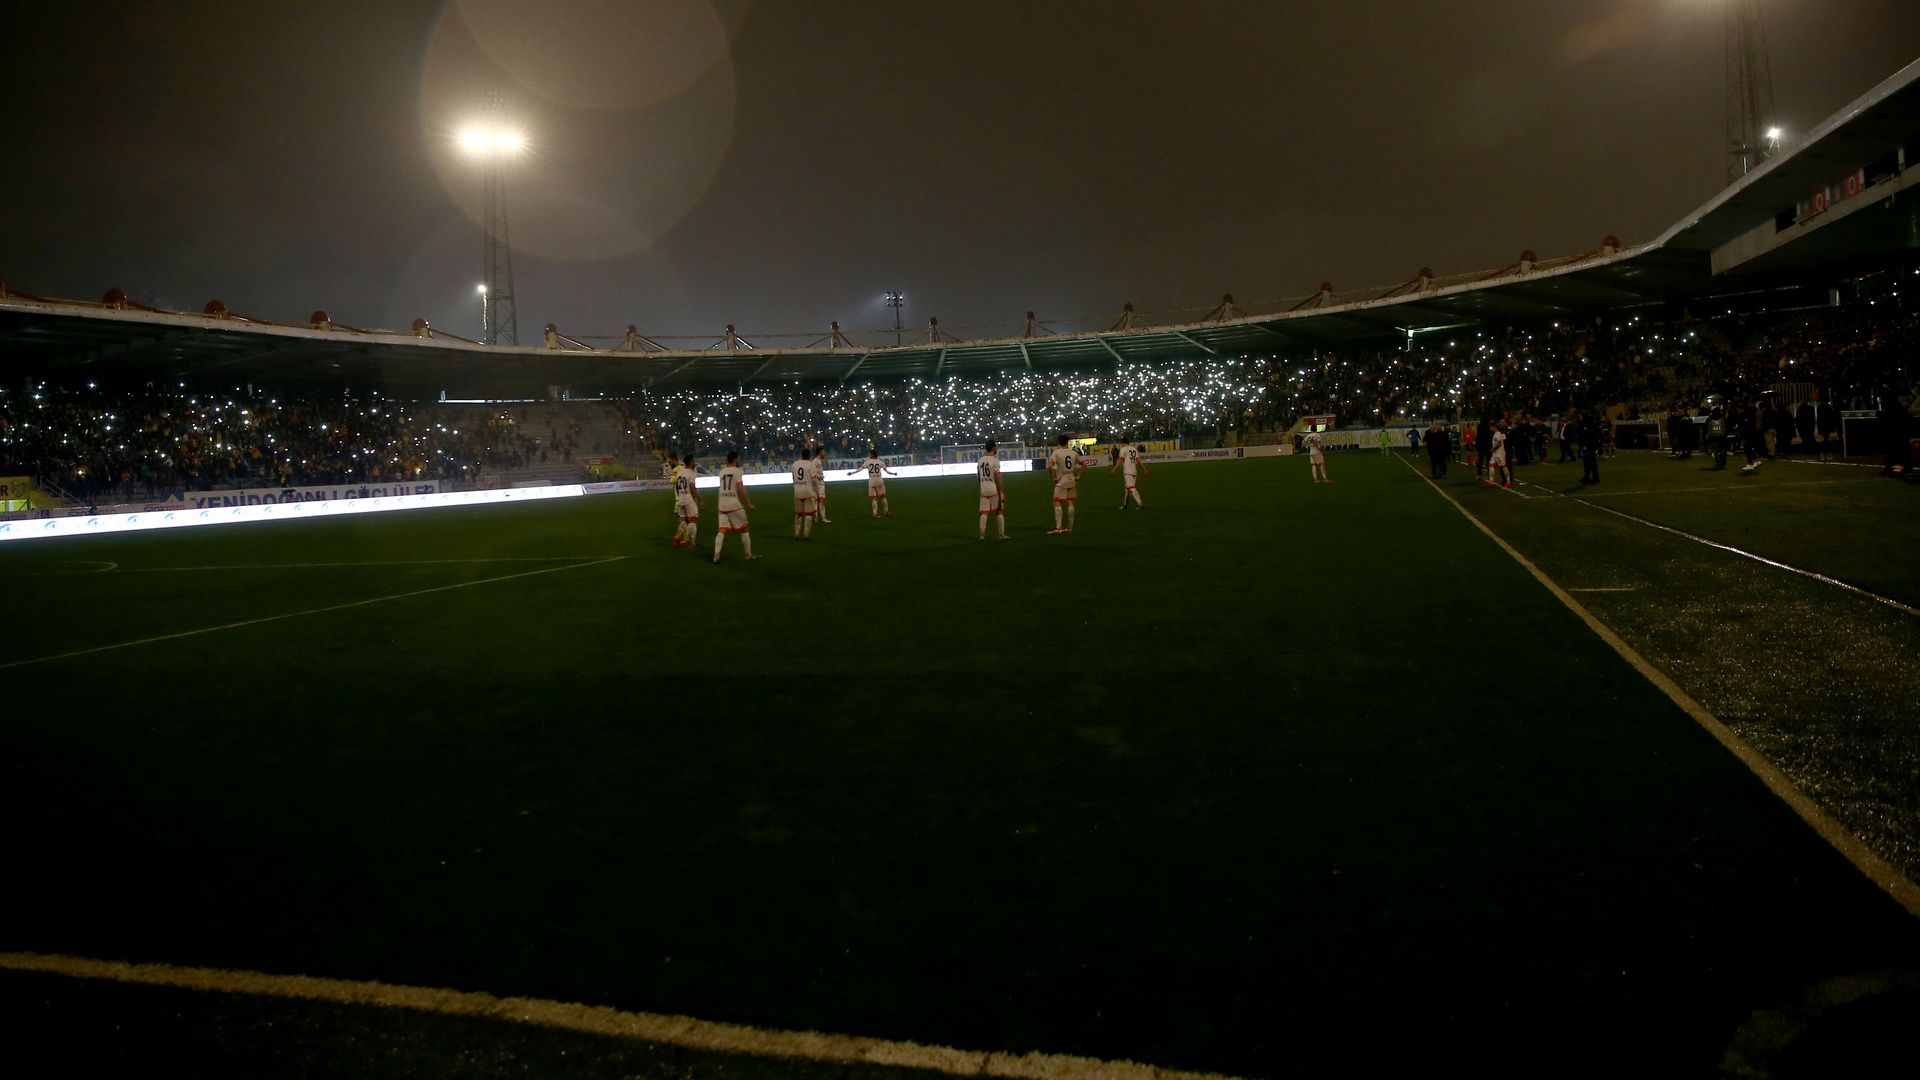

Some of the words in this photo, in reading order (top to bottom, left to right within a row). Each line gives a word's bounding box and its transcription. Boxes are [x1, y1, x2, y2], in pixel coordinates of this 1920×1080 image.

[869, 463, 880, 474] 26
[981, 462, 991, 478] 16
[1065, 456, 1072, 470] 6
[797, 467, 804, 481] 9
[721, 474, 733, 491] 17
